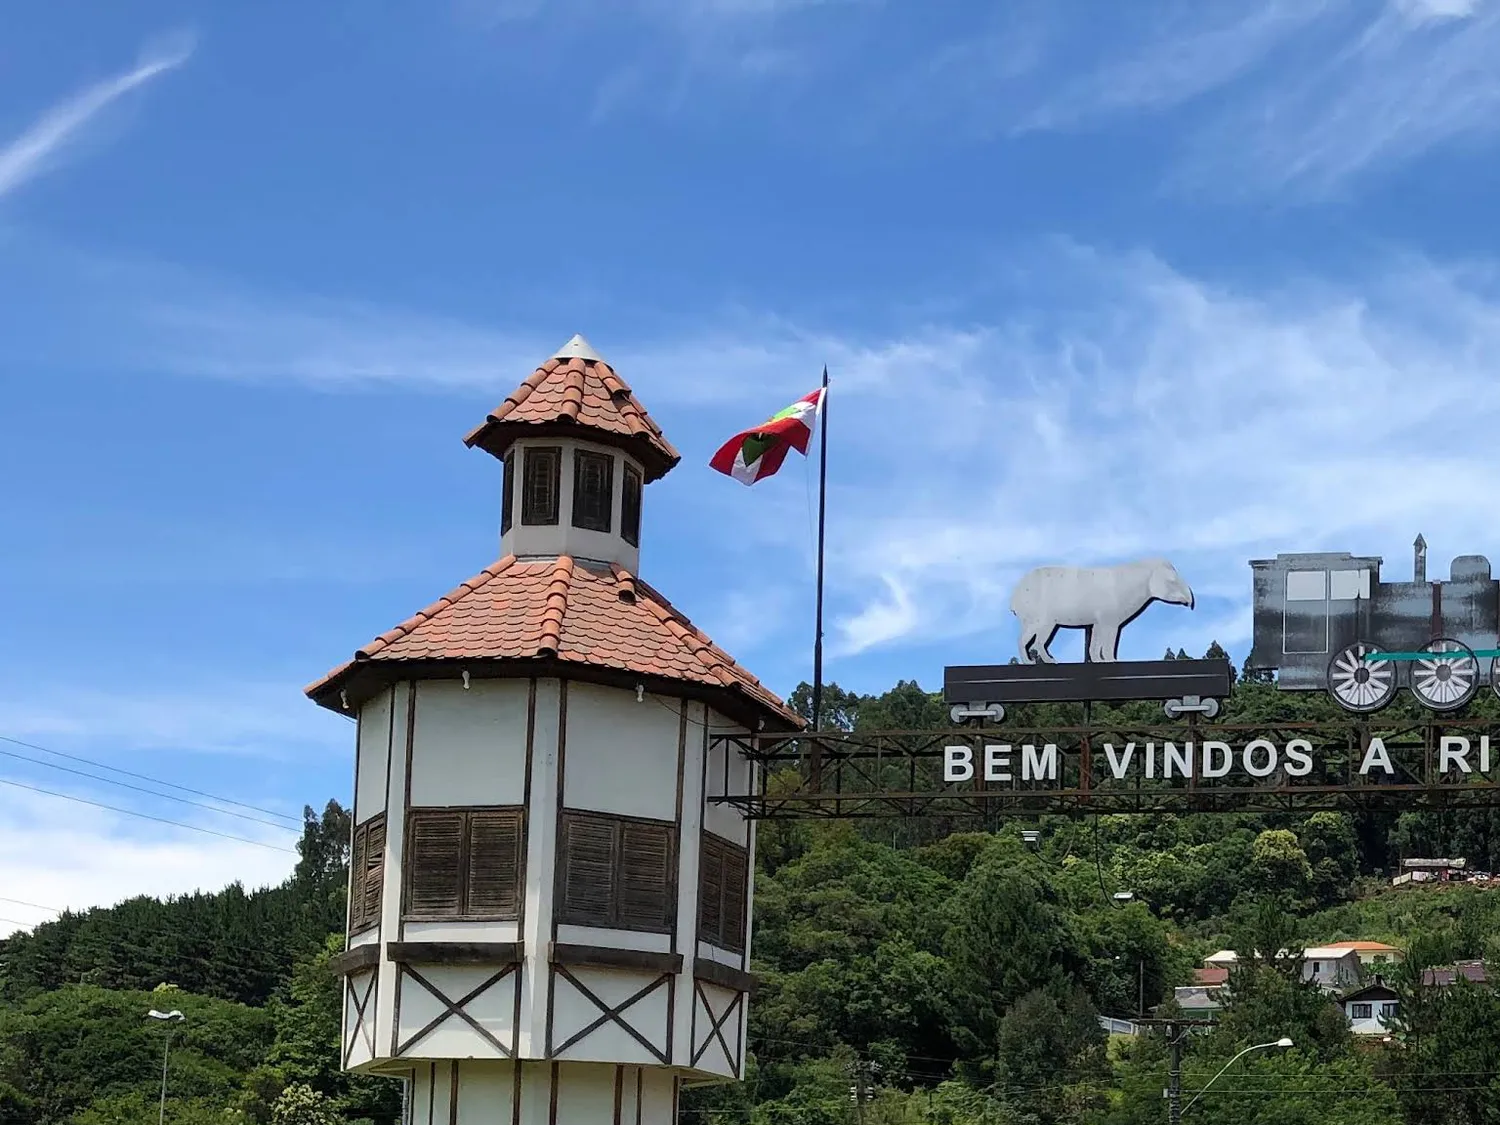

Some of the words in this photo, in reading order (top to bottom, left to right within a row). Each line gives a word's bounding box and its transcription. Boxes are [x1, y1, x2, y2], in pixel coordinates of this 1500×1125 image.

[943, 743, 1057, 782] BEM
[1103, 738, 1313, 779] VINDOS
[1358, 737, 1395, 775] A
